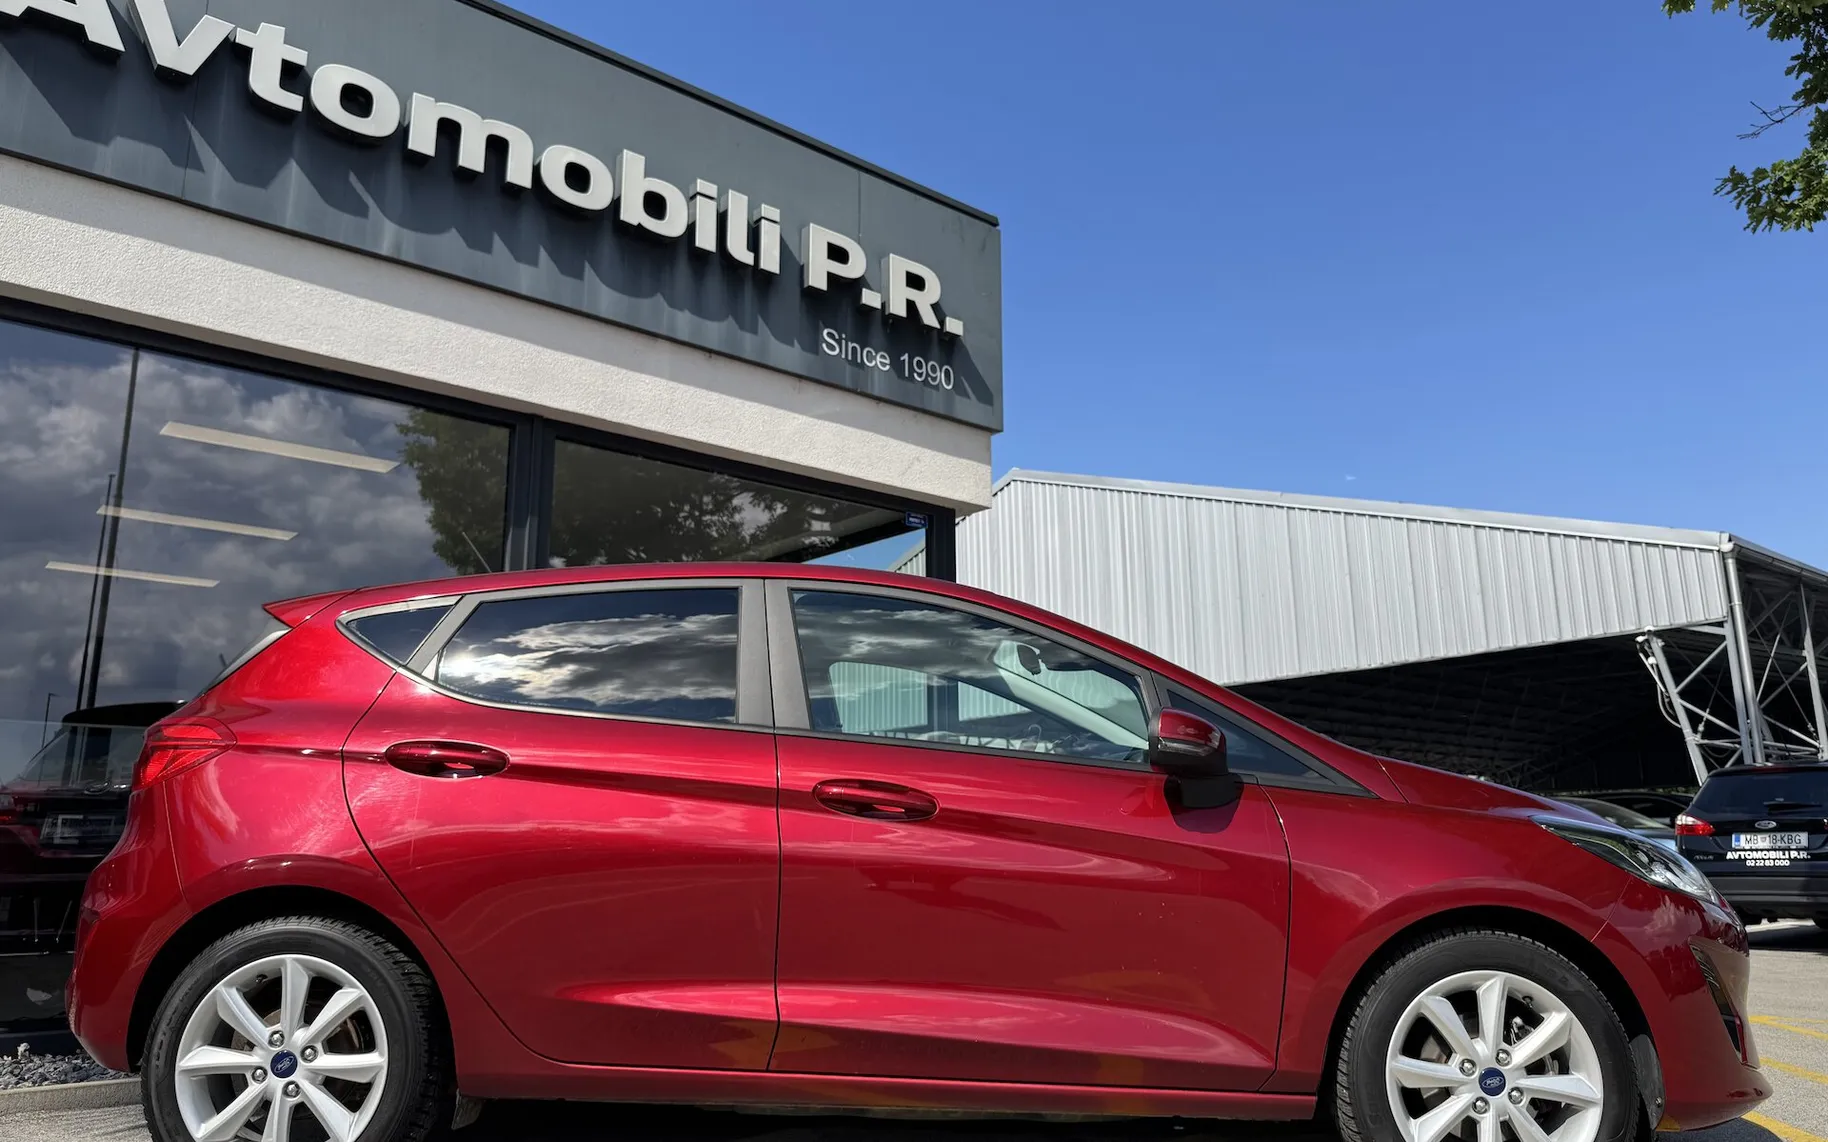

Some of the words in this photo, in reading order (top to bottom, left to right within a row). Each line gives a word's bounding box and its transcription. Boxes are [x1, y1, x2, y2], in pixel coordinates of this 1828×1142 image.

[802, 222, 964, 337] P.R.
[821, 328, 890, 372] Since
[900, 352, 954, 390] 1990
[1726, 851, 1789, 860] AVTOMOBILI
[1790, 851, 1811, 859] P.R.
[1744, 834, 1759, 845] MB
